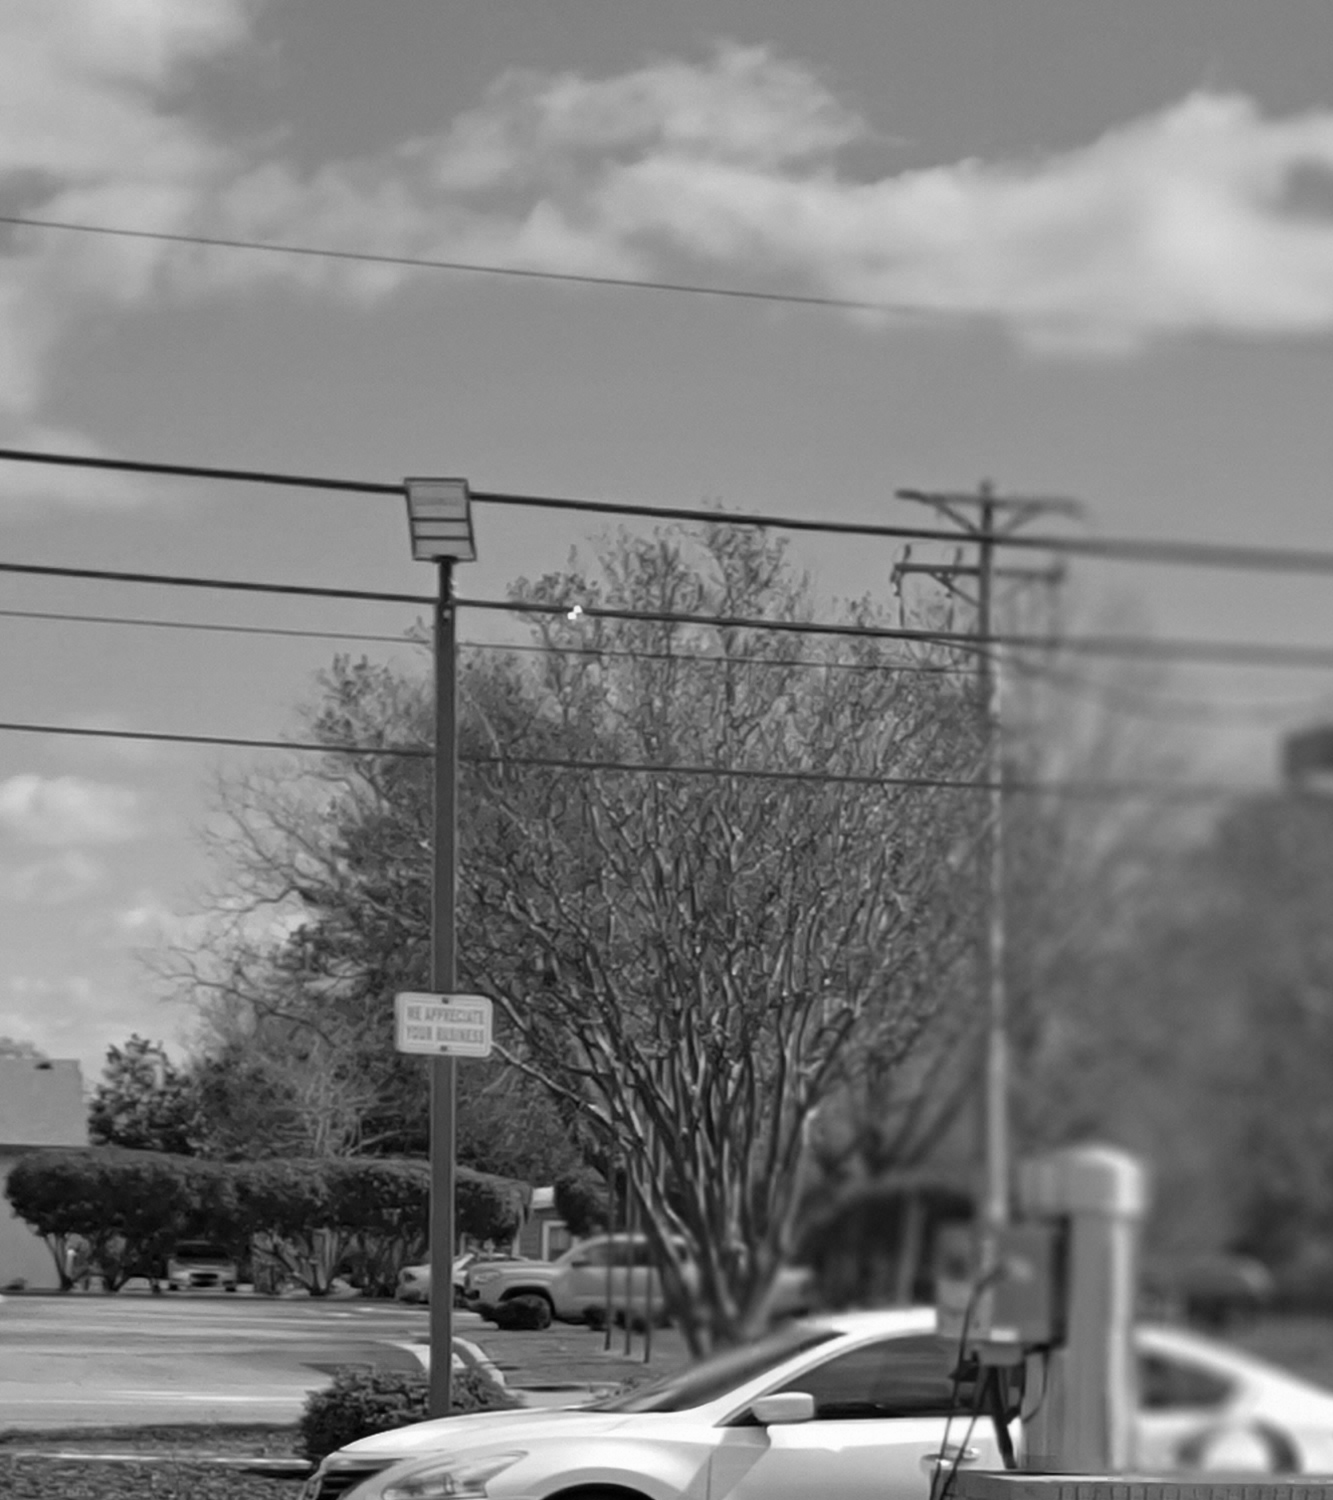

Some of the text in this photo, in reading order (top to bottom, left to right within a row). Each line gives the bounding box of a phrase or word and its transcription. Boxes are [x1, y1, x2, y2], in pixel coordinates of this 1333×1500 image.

[425, 1006, 484, 1026] APPRECIATE
[406, 1026, 485, 1045] YOUR BUSINESS
